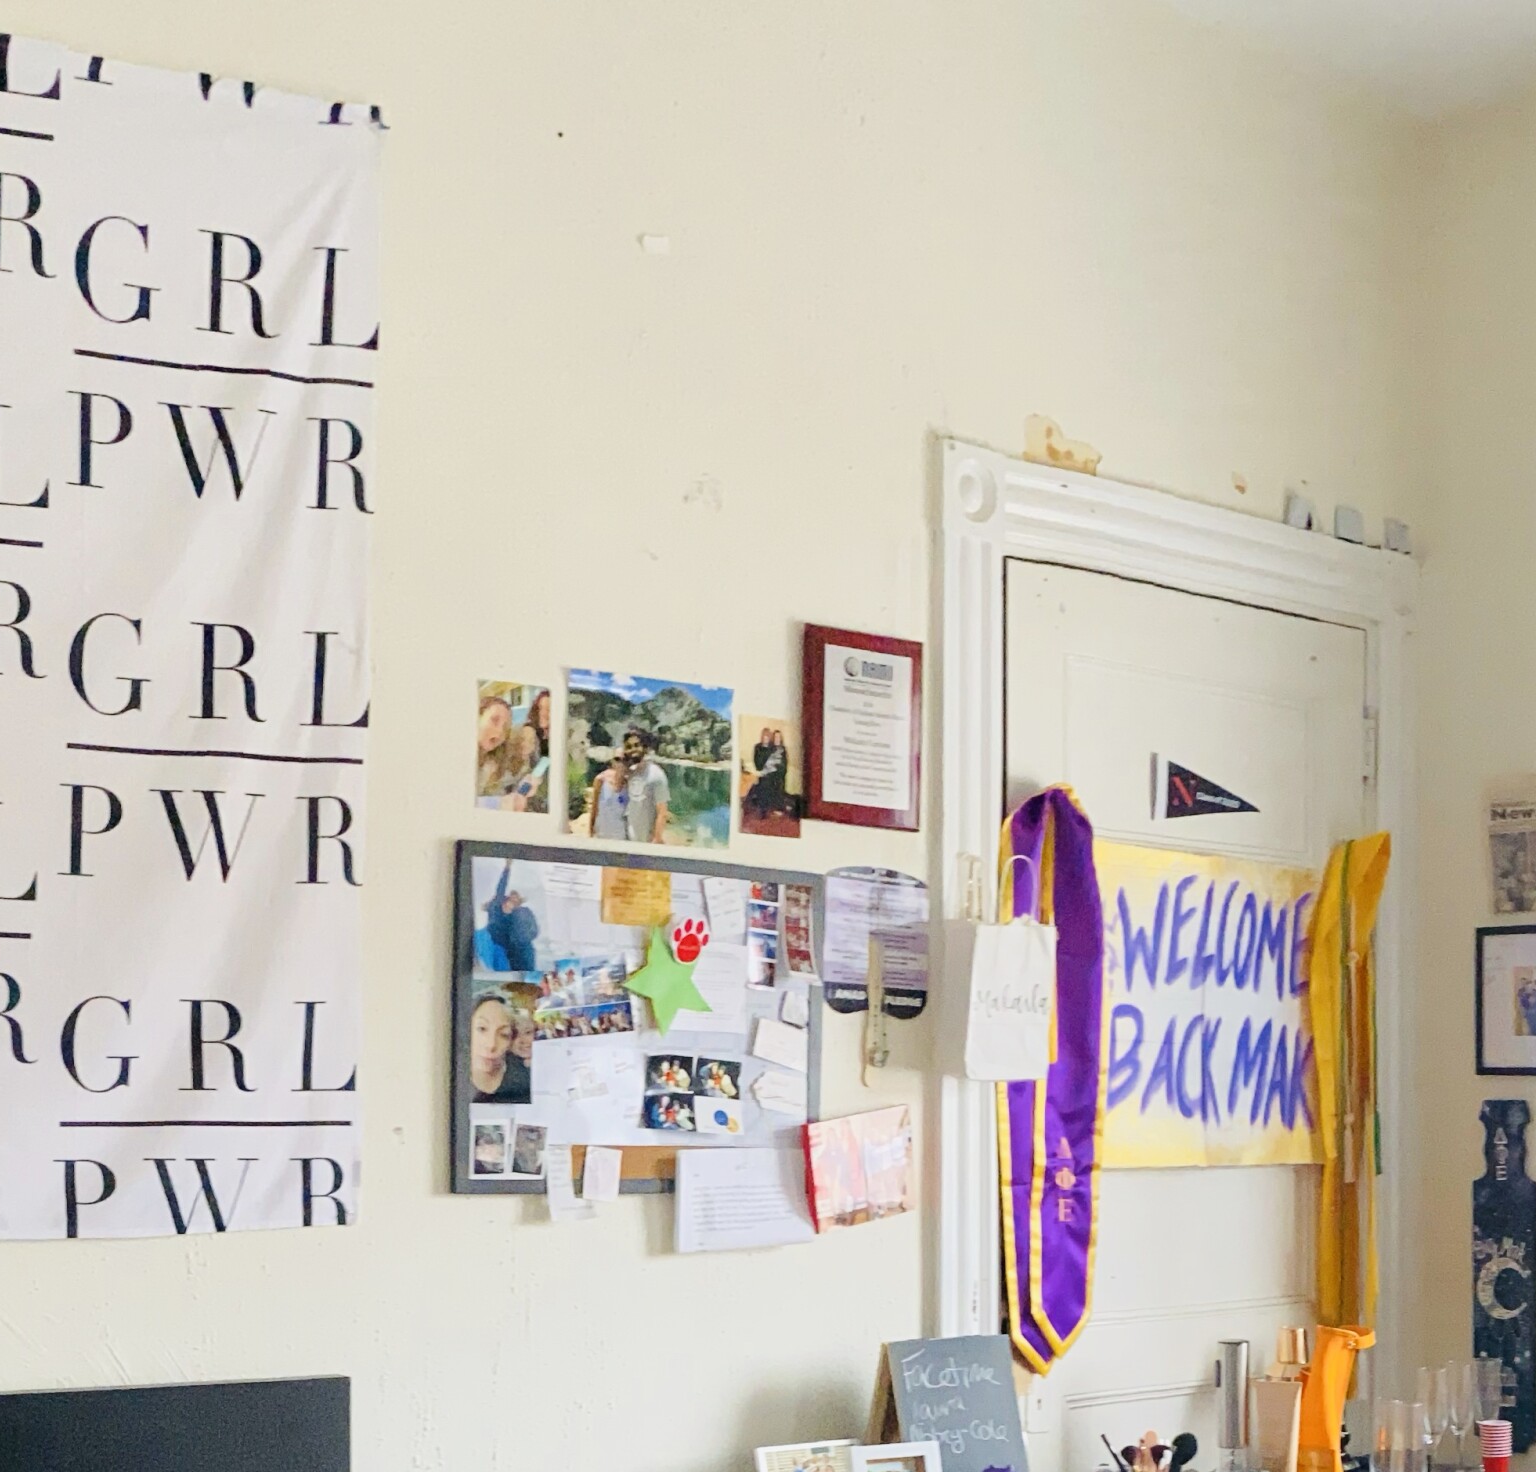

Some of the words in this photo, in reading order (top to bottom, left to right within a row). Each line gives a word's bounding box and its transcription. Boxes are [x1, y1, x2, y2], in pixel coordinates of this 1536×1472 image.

[74, 216, 380, 352] GRL
[67, 390, 374, 515] PWR
[68, 612, 370, 728] GRL
[59, 783, 363, 887] PWR
[1117, 874, 1314, 1002] WELCOME
[60, 995, 357, 1094] GRL
[1107, 1003, 1222, 1128] BACK
